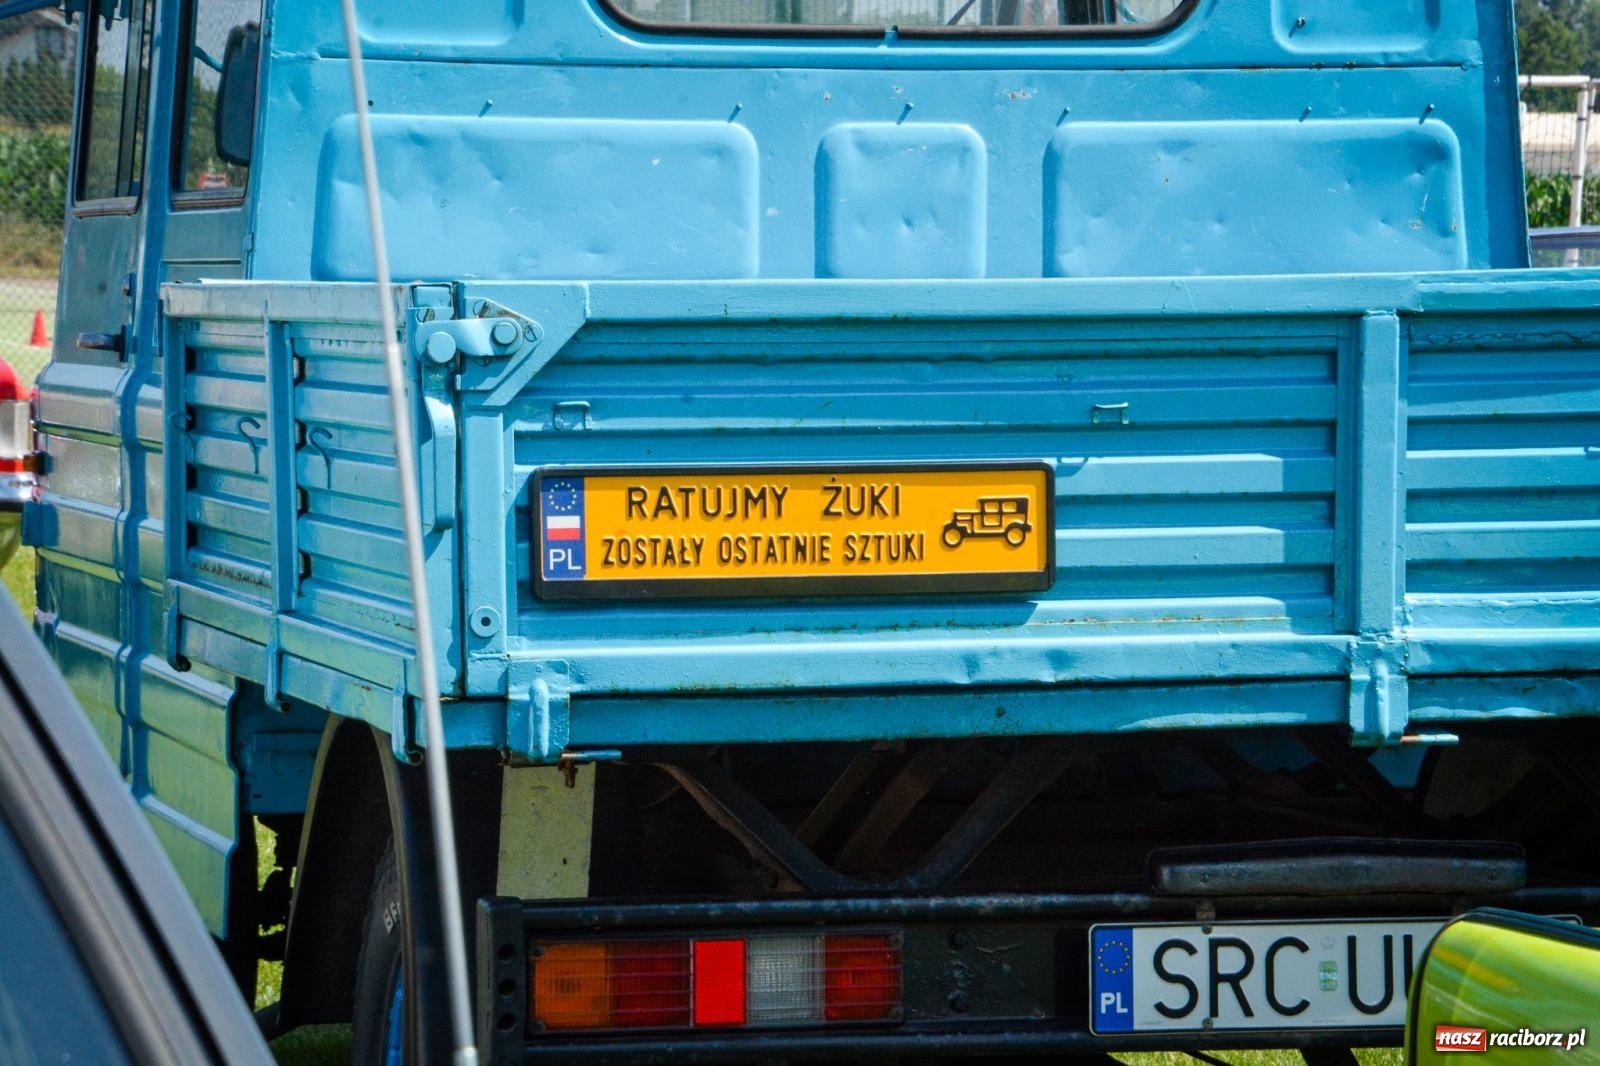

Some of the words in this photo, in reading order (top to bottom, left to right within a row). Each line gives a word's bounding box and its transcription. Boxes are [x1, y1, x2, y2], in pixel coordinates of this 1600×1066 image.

[626, 486, 788, 519] RATUJMY
[822, 477, 901, 517] ŻUKI
[549, 549, 581, 570] PL
[603, 537, 704, 565] ZOSTAŁY
[718, 534, 831, 563] OSTATNIE
[845, 532, 925, 561] SZTUKI
[383, 901, 401, 934] BF
[1153, 935, 1311, 1020] SRC
[1100, 992, 1128, 1014] PL
